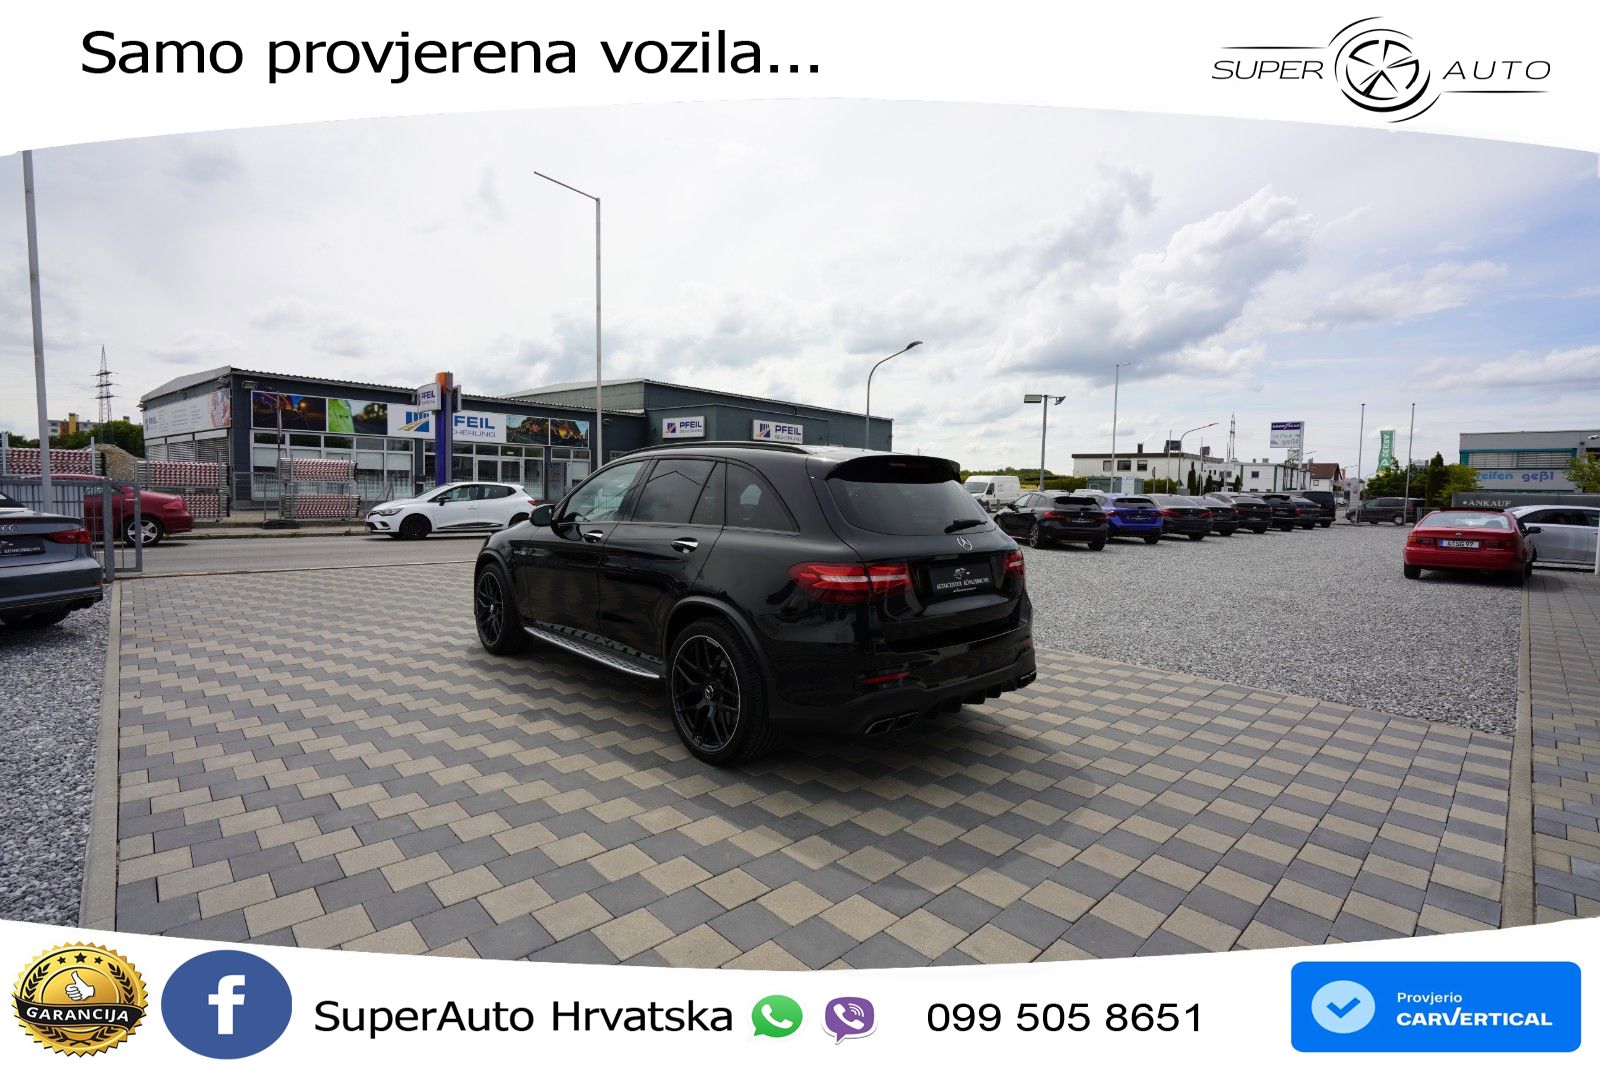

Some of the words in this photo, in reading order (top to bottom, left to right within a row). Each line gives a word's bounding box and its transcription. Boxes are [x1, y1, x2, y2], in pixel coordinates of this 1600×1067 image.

[453, 415, 496, 430] FEIL
[679, 421, 703, 429] PFEIL
[774, 424, 802, 436] PFEIL
[1468, 499, 1512, 508] ANKAUF
